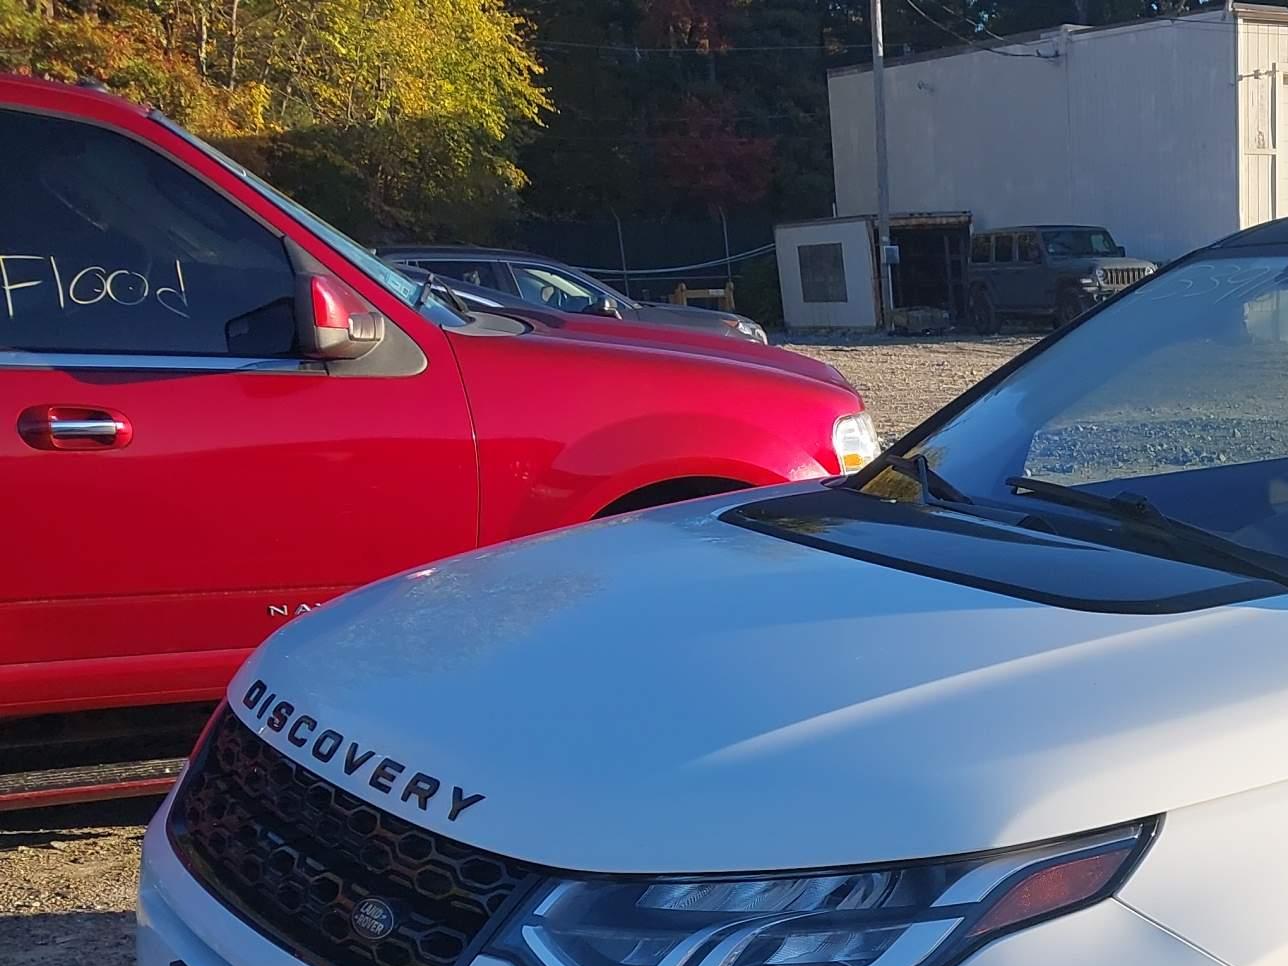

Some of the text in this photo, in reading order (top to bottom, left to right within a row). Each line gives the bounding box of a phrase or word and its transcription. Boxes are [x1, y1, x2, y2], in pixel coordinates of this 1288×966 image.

[0, 255, 190, 319] Flood
[242, 679, 486, 822] DISCOVERY
[355, 914, 384, 935] ROVER
[360, 902, 384, 920] LAND
